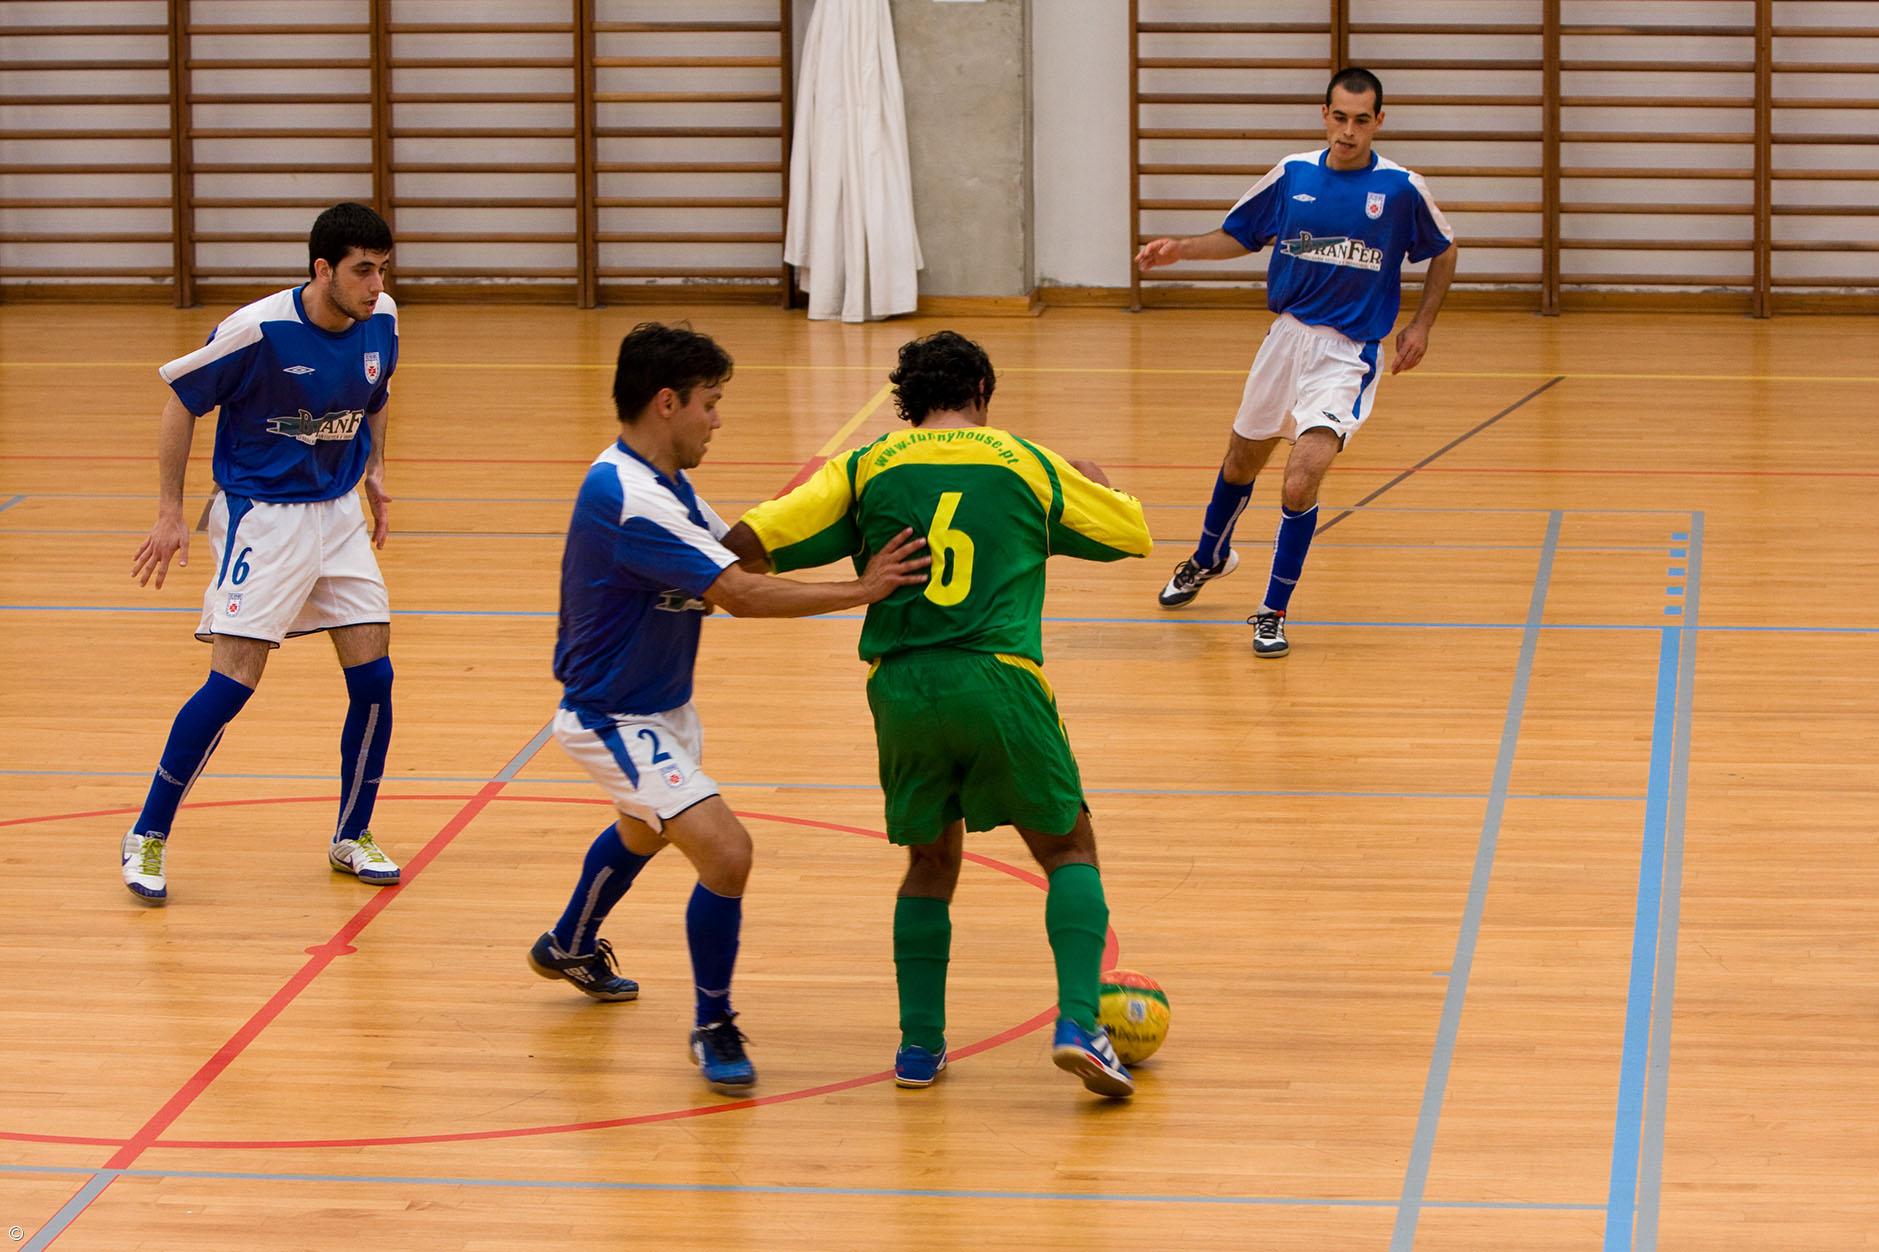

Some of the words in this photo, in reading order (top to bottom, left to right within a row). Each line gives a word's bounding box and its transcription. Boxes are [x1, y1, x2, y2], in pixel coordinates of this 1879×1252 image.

[875, 429, 1020, 468] www.funnyhouse.pt
[232, 547, 252, 586] 6
[924, 491, 975, 607] 6
[637, 728, 673, 765] 2
